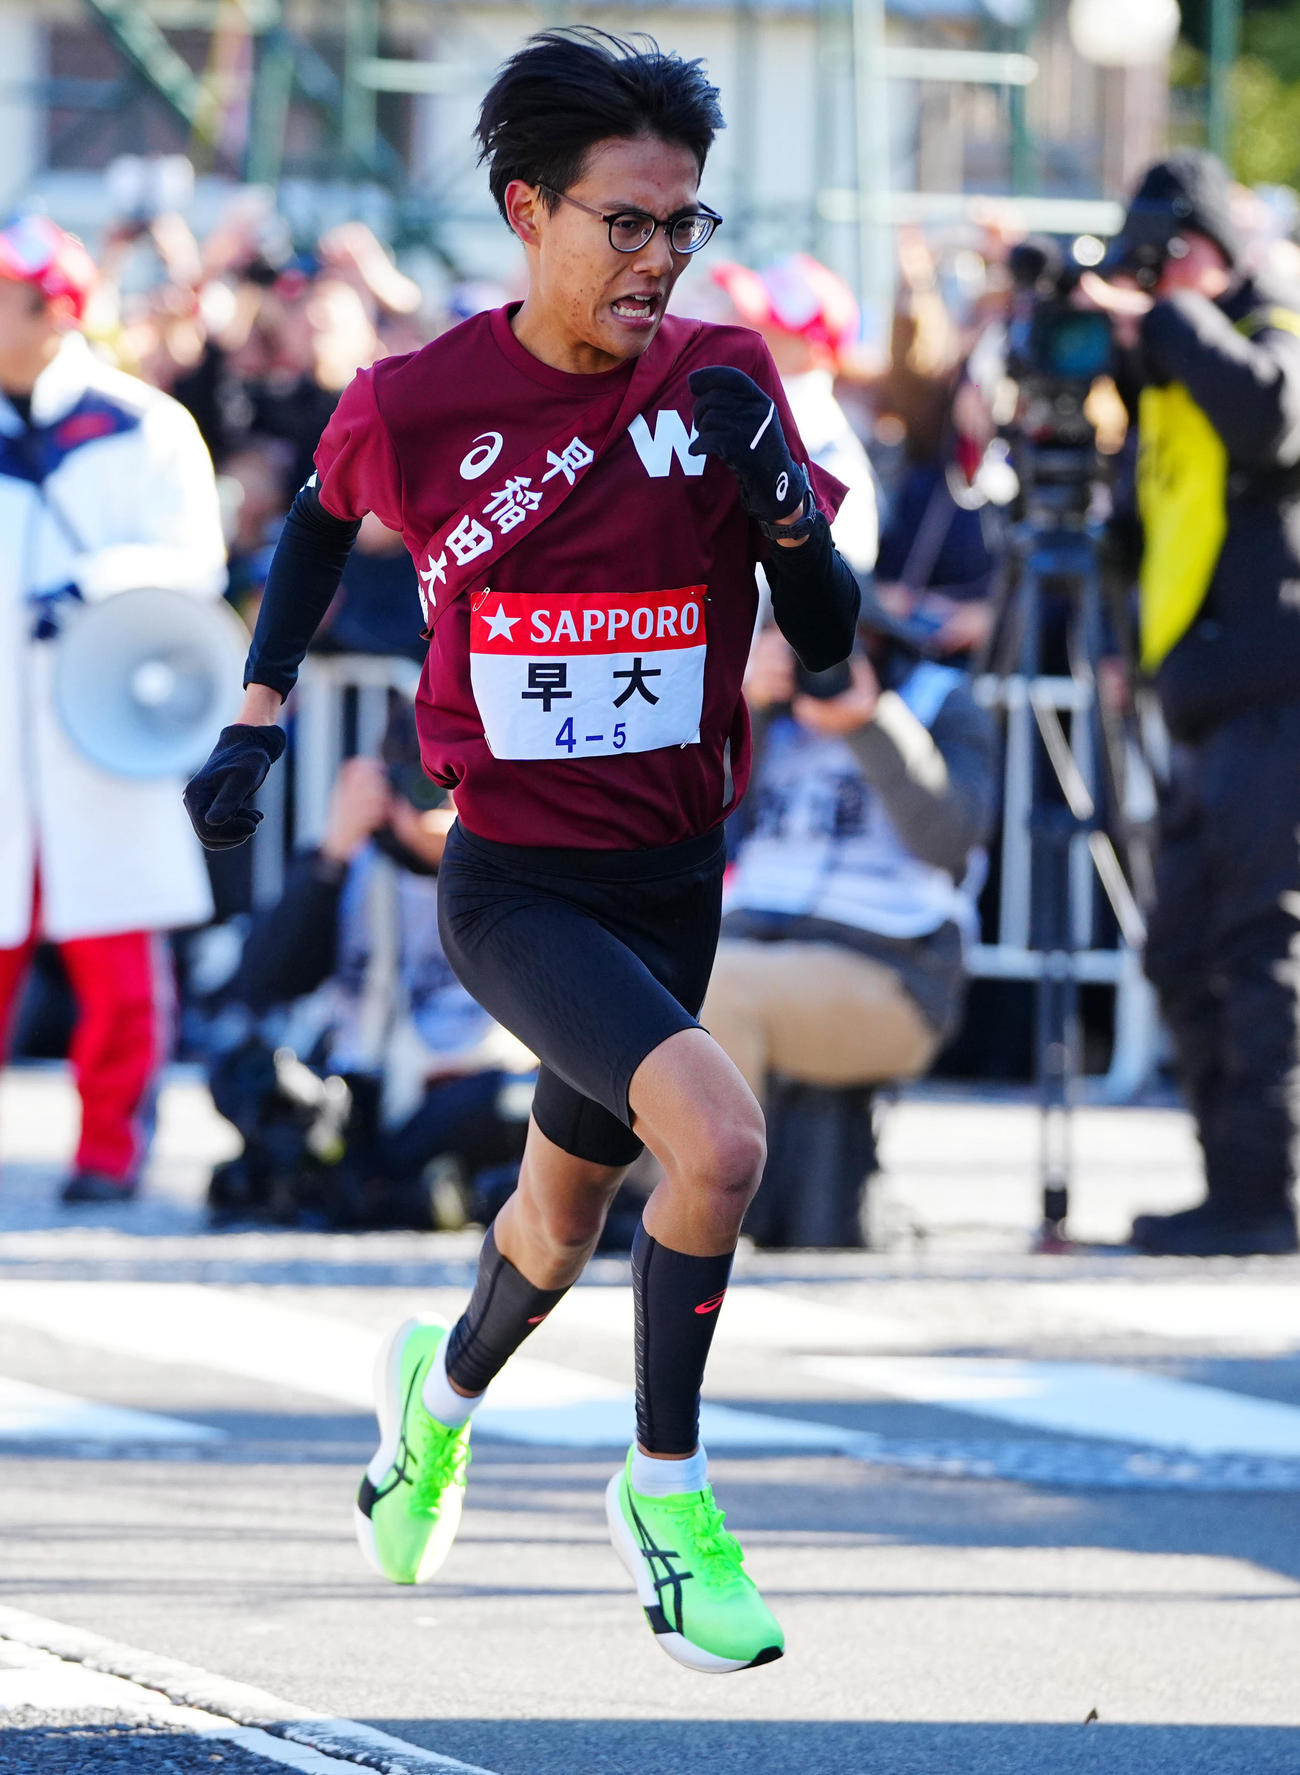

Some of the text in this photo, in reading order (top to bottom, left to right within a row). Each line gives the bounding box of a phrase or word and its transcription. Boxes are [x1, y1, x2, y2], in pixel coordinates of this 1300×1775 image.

[627, 409, 707, 478] W
[417, 436, 595, 624] 早稲田大
[530, 602, 699, 643] SAPPORO
